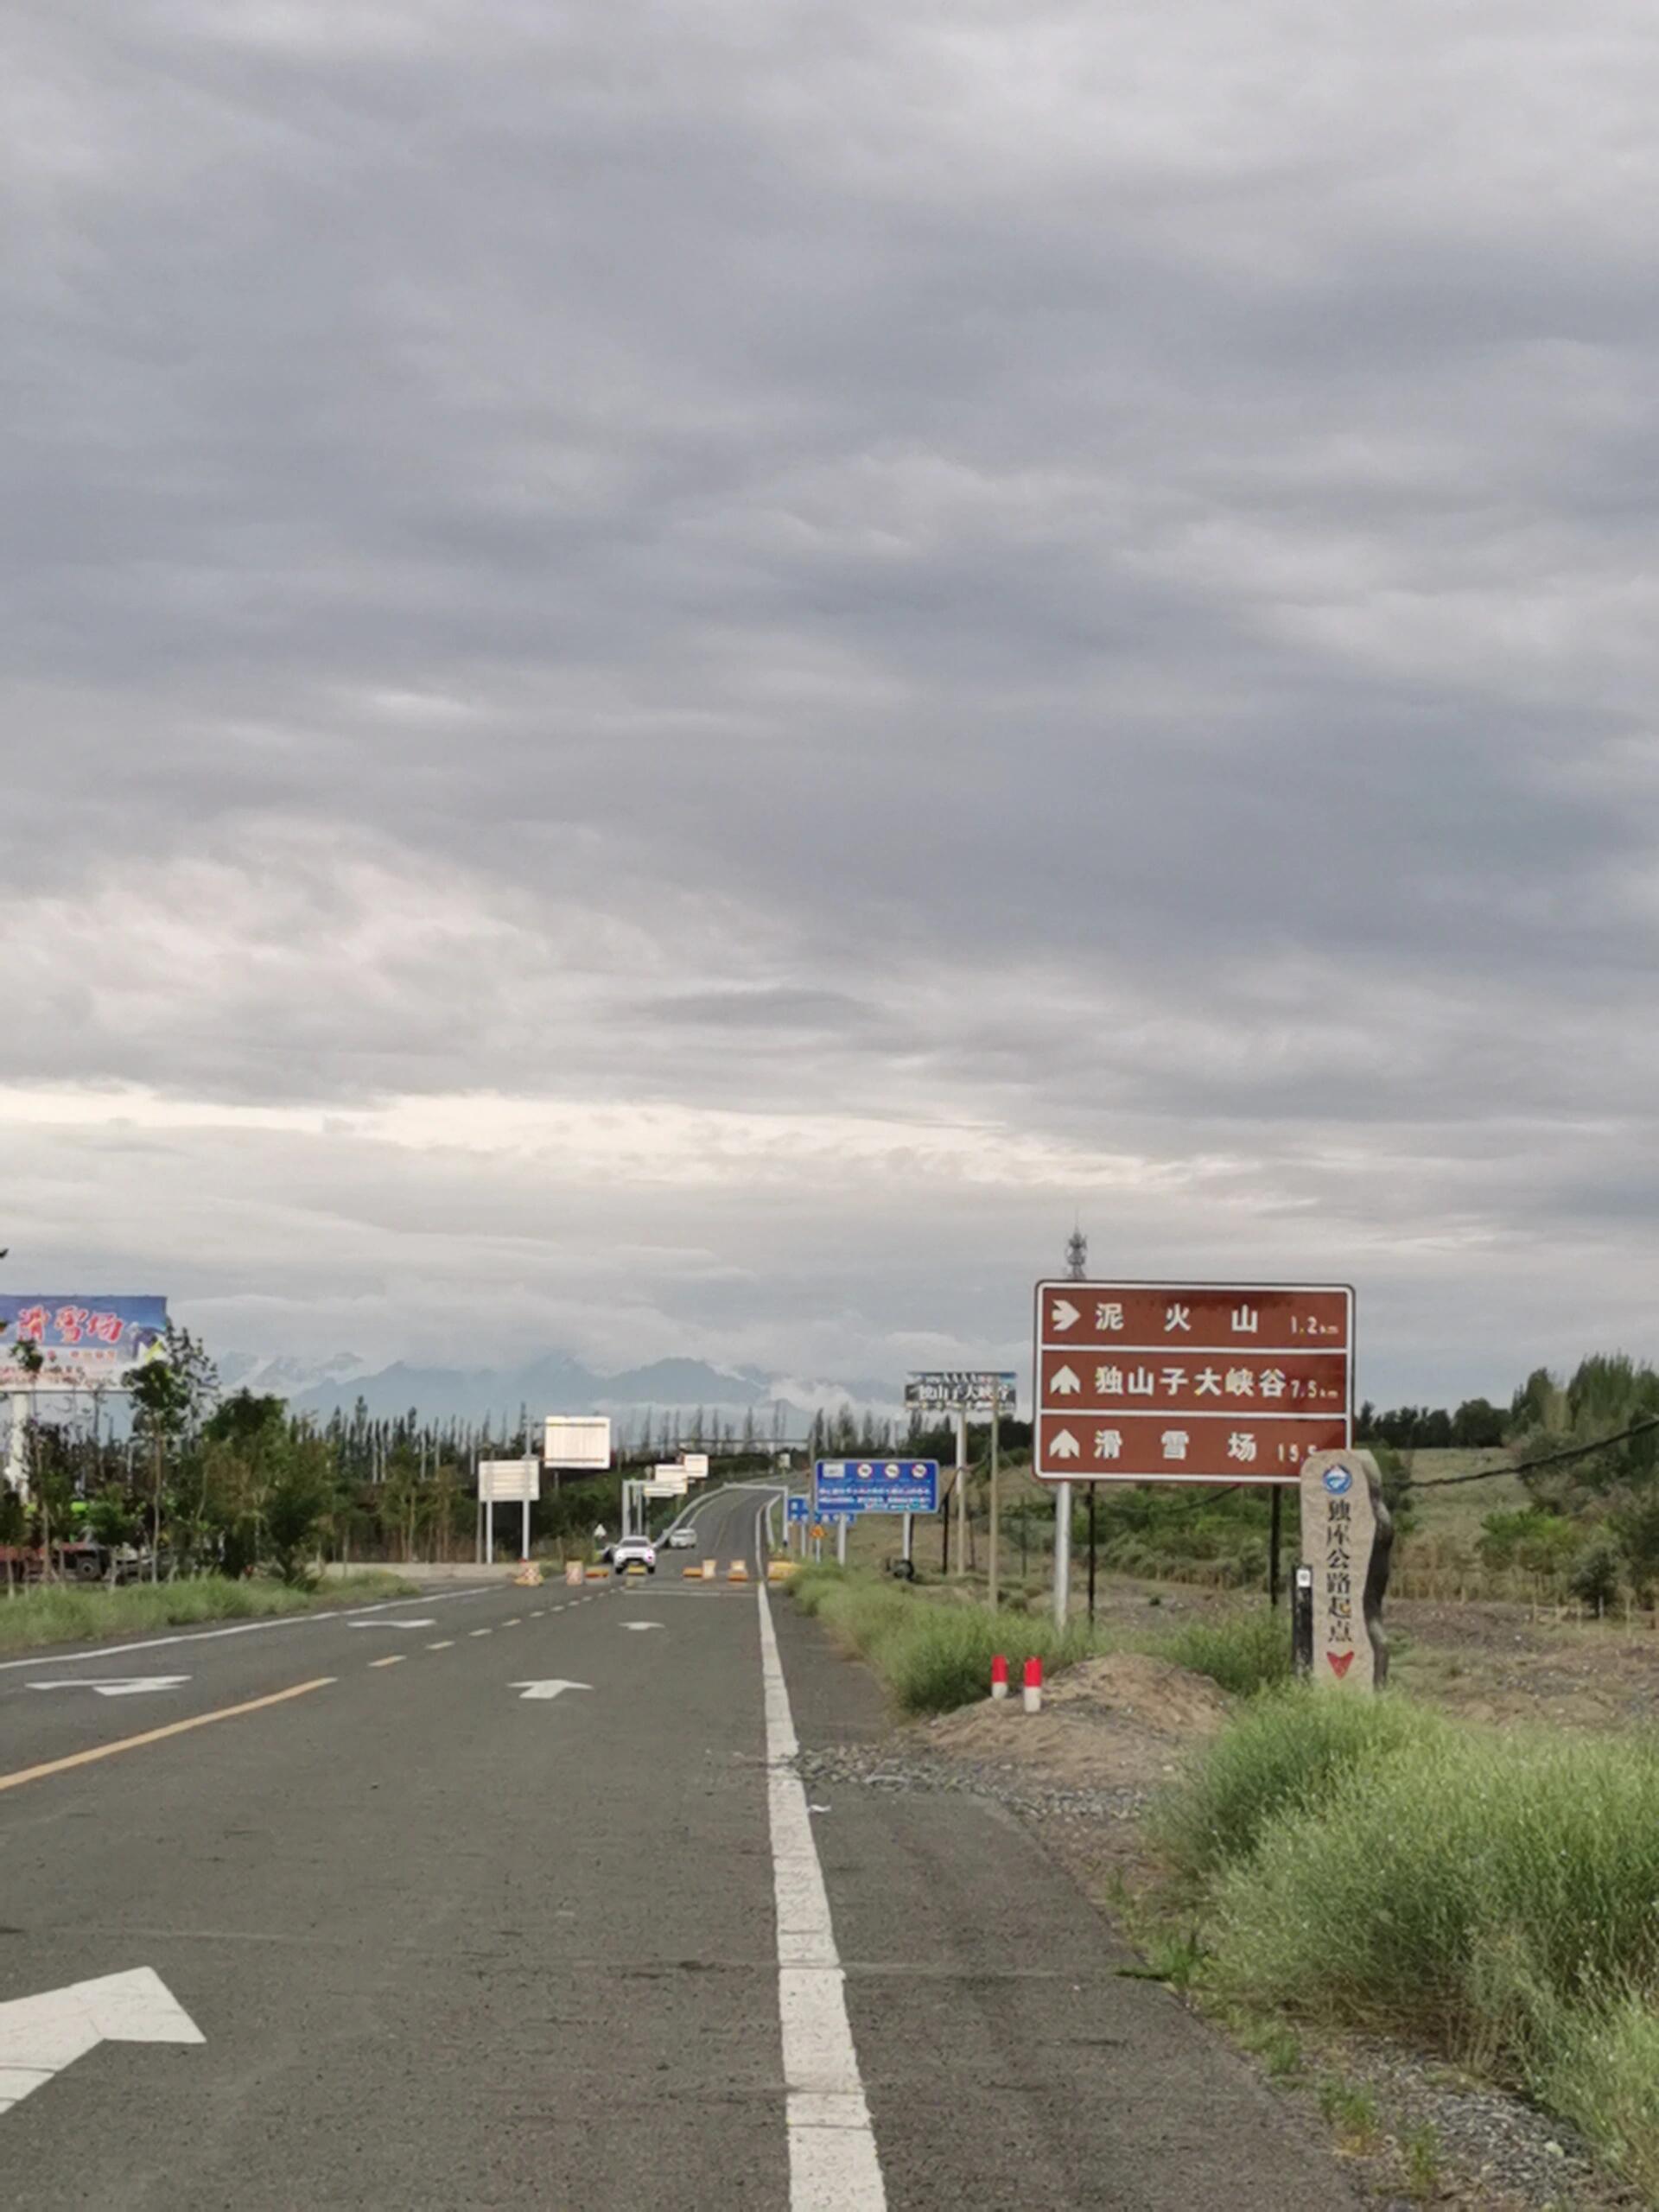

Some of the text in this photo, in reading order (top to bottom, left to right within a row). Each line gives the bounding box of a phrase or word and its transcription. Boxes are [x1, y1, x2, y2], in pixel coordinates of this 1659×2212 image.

[1096, 1303, 1338, 1334] 泥火山 1.2km
[1094, 1365, 1338, 1398] 独山子大峡谷 7.5km
[1093, 1429, 1257, 1461] 滑雪场
[1326, 1499, 1351, 1643] 独库公路起点
